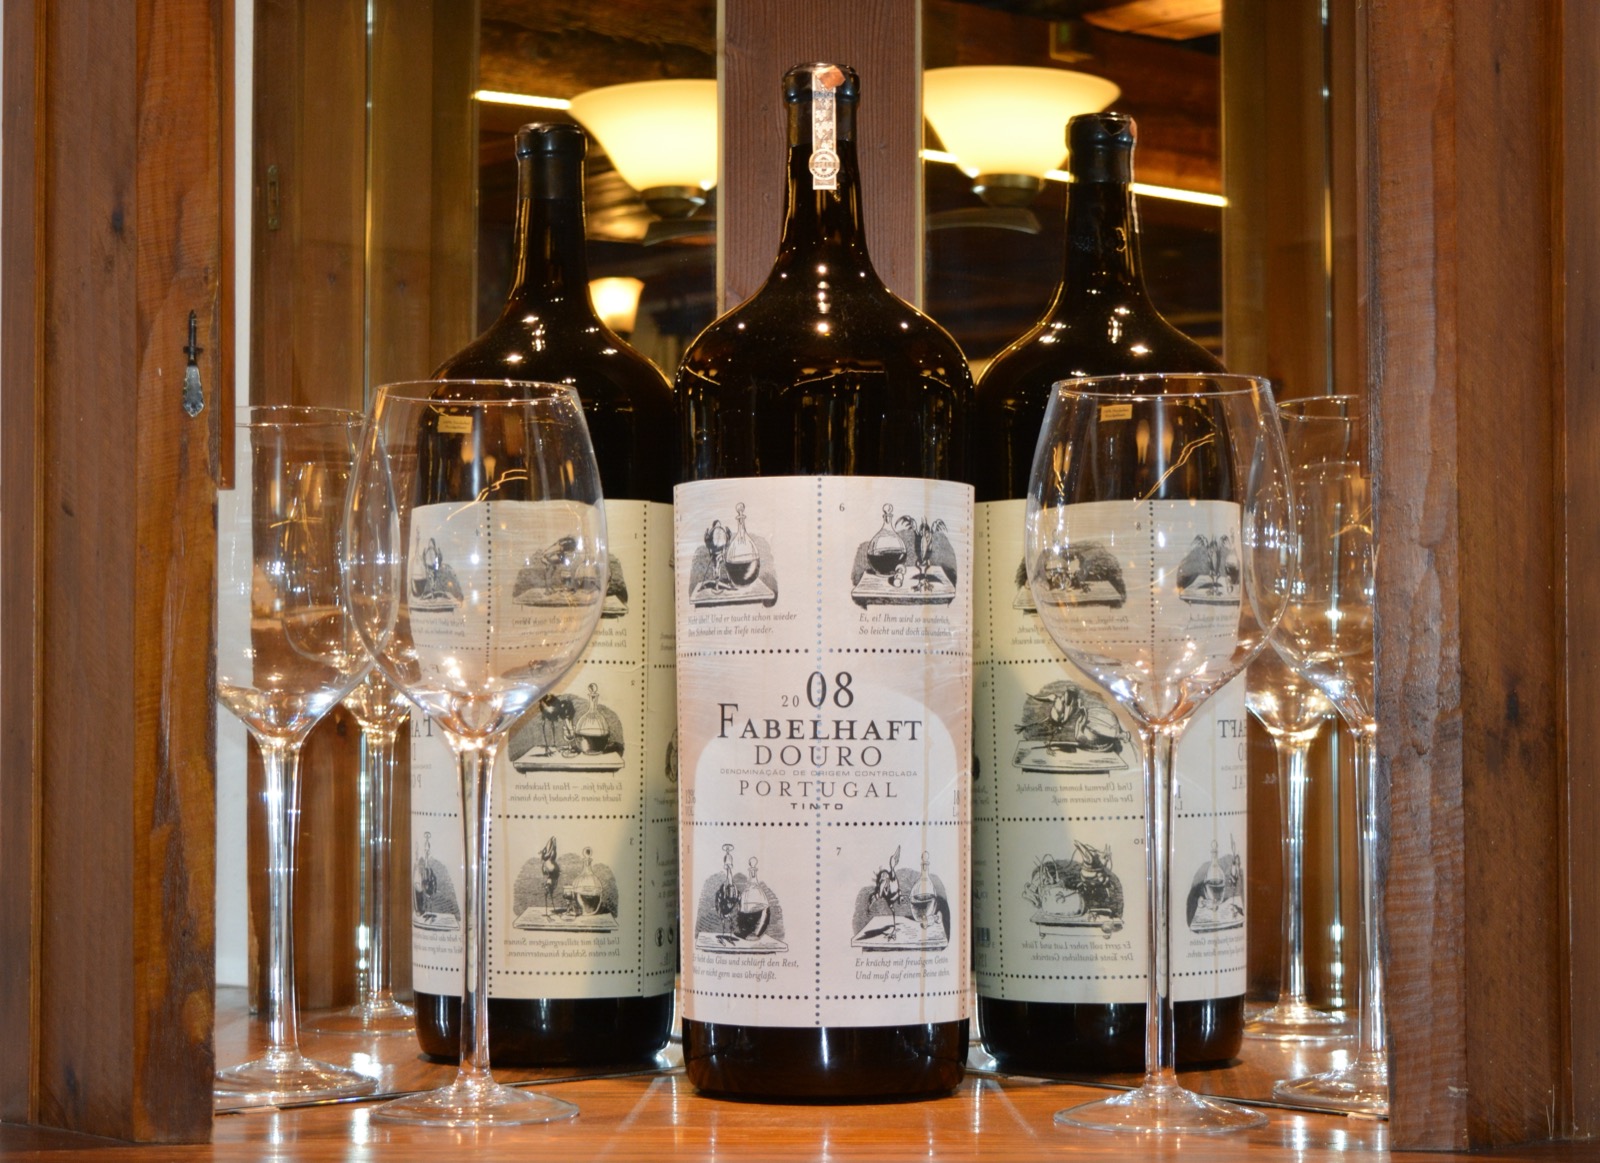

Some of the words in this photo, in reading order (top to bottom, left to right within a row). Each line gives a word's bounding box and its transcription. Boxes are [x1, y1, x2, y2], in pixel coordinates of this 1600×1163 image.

[838, 502, 845, 512] 6
[711, 614, 722, 623] Und
[731, 612, 751, 622] taucht
[752, 611, 771, 622] schon
[774, 612, 797, 621] wieder
[860, 613, 869, 623] Ei,
[872, 614, 882, 623] ei!
[884, 614, 897, 623] Ihm
[899, 614, 914, 623] wird
[723, 626, 732, 635] die
[734, 626, 749, 637] Tiefe
[750, 625, 774, 634] nieder.
[859, 626, 869, 636] So
[870, 626, 889, 636] leicht
[892, 627, 904, 636] und
[906, 628, 920, 636] doch
[782, 695, 800, 708] 20
[806, 671, 854, 708] 08
[717, 702, 923, 741] FABELHAFT
[754, 744, 882, 767] DOURO
[720, 768, 786, 778] DENOMINAÇÃO
[810, 769, 851, 777] ORIGEM
[739, 780, 898, 798] PORTUGAL
[790, 802, 844, 811] TINTO
[836, 846, 842, 856] 7
[706, 955, 714, 964] das
[715, 956, 728, 965] Glas
[730, 956, 740, 965] und
[741, 957, 765, 969] schlürft
[767, 959, 780, 967] den
[782, 959, 799, 968] Rest,
[856, 958, 864, 967] Er
[866, 958, 891, 968] krächzt
[893, 958, 904, 966] mit
[904, 957, 933, 969] freudigem
[706, 968, 718, 977] nicht
[718, 970, 730, 980] gern
[744, 971, 777, 982] übrigläßt.
[855, 971, 872, 980] Und
[873, 970, 889, 982] muß
[891, 970, 904, 982] auf
[904, 971, 921, 979] einem
[923, 969, 937, 978] Beine
